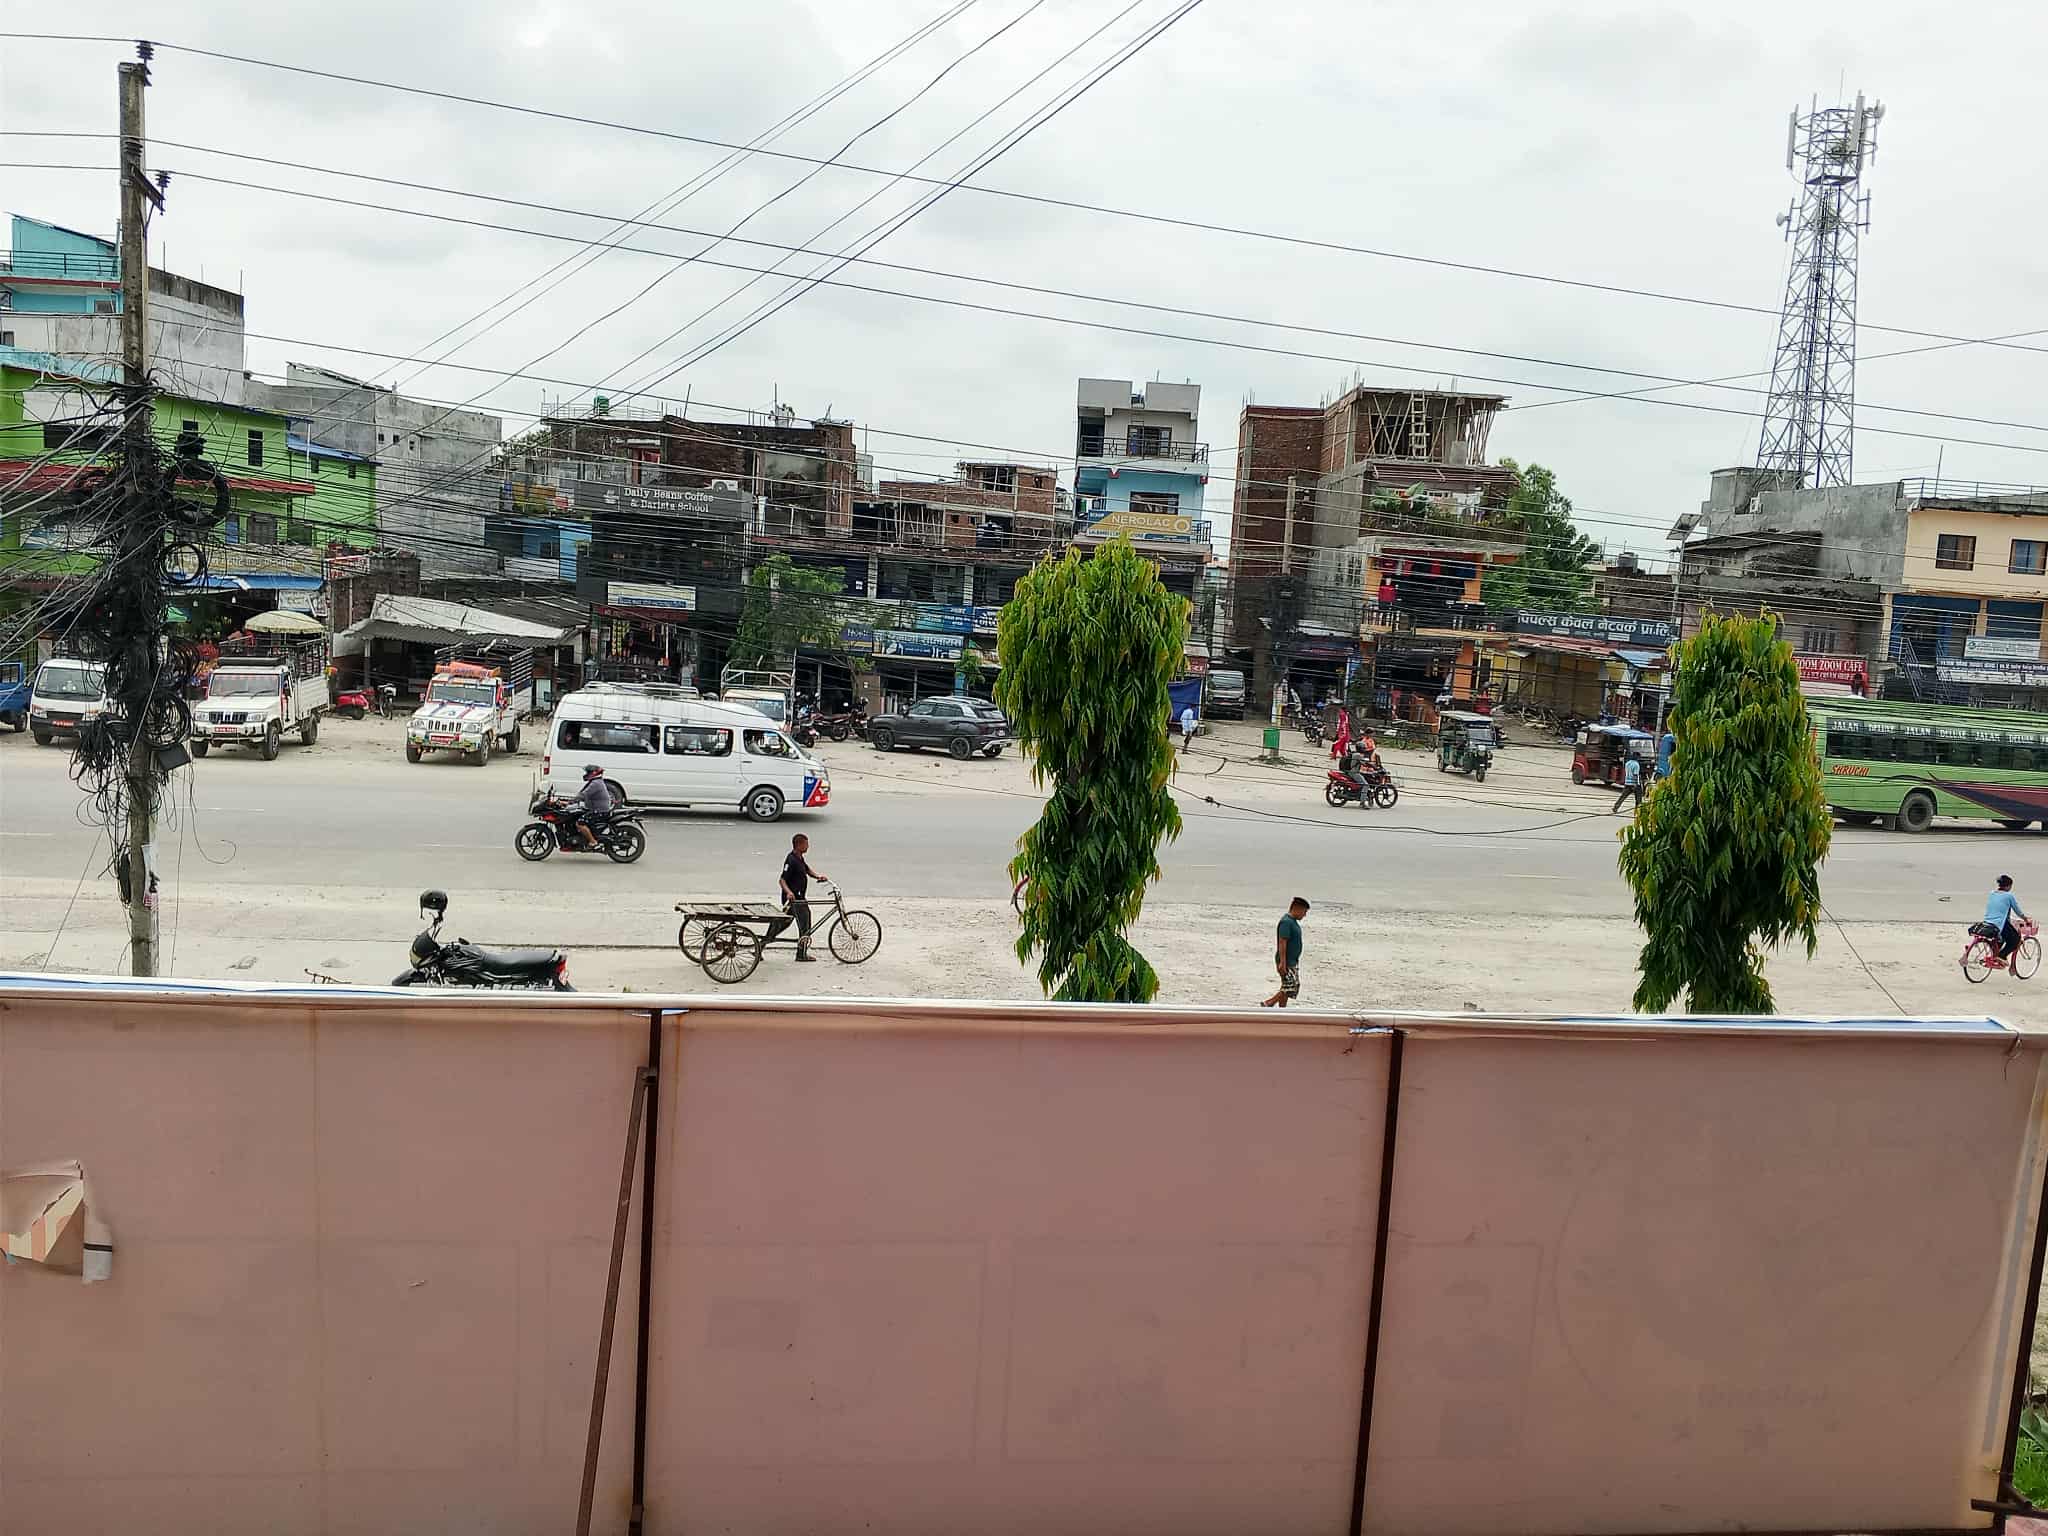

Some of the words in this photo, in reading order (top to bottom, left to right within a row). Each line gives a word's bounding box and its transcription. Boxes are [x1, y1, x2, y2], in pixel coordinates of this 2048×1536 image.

[624, 487, 650, 499] Daily
[684, 491, 714, 503] Coffee
[677, 501, 709, 513] School
[1112, 514, 1170, 528] NEROLAC
[1820, 659, 1842, 672] ZOOM
[1844, 660, 1863, 673] CAFE
[1904, 725, 1931, 737] JALAN
